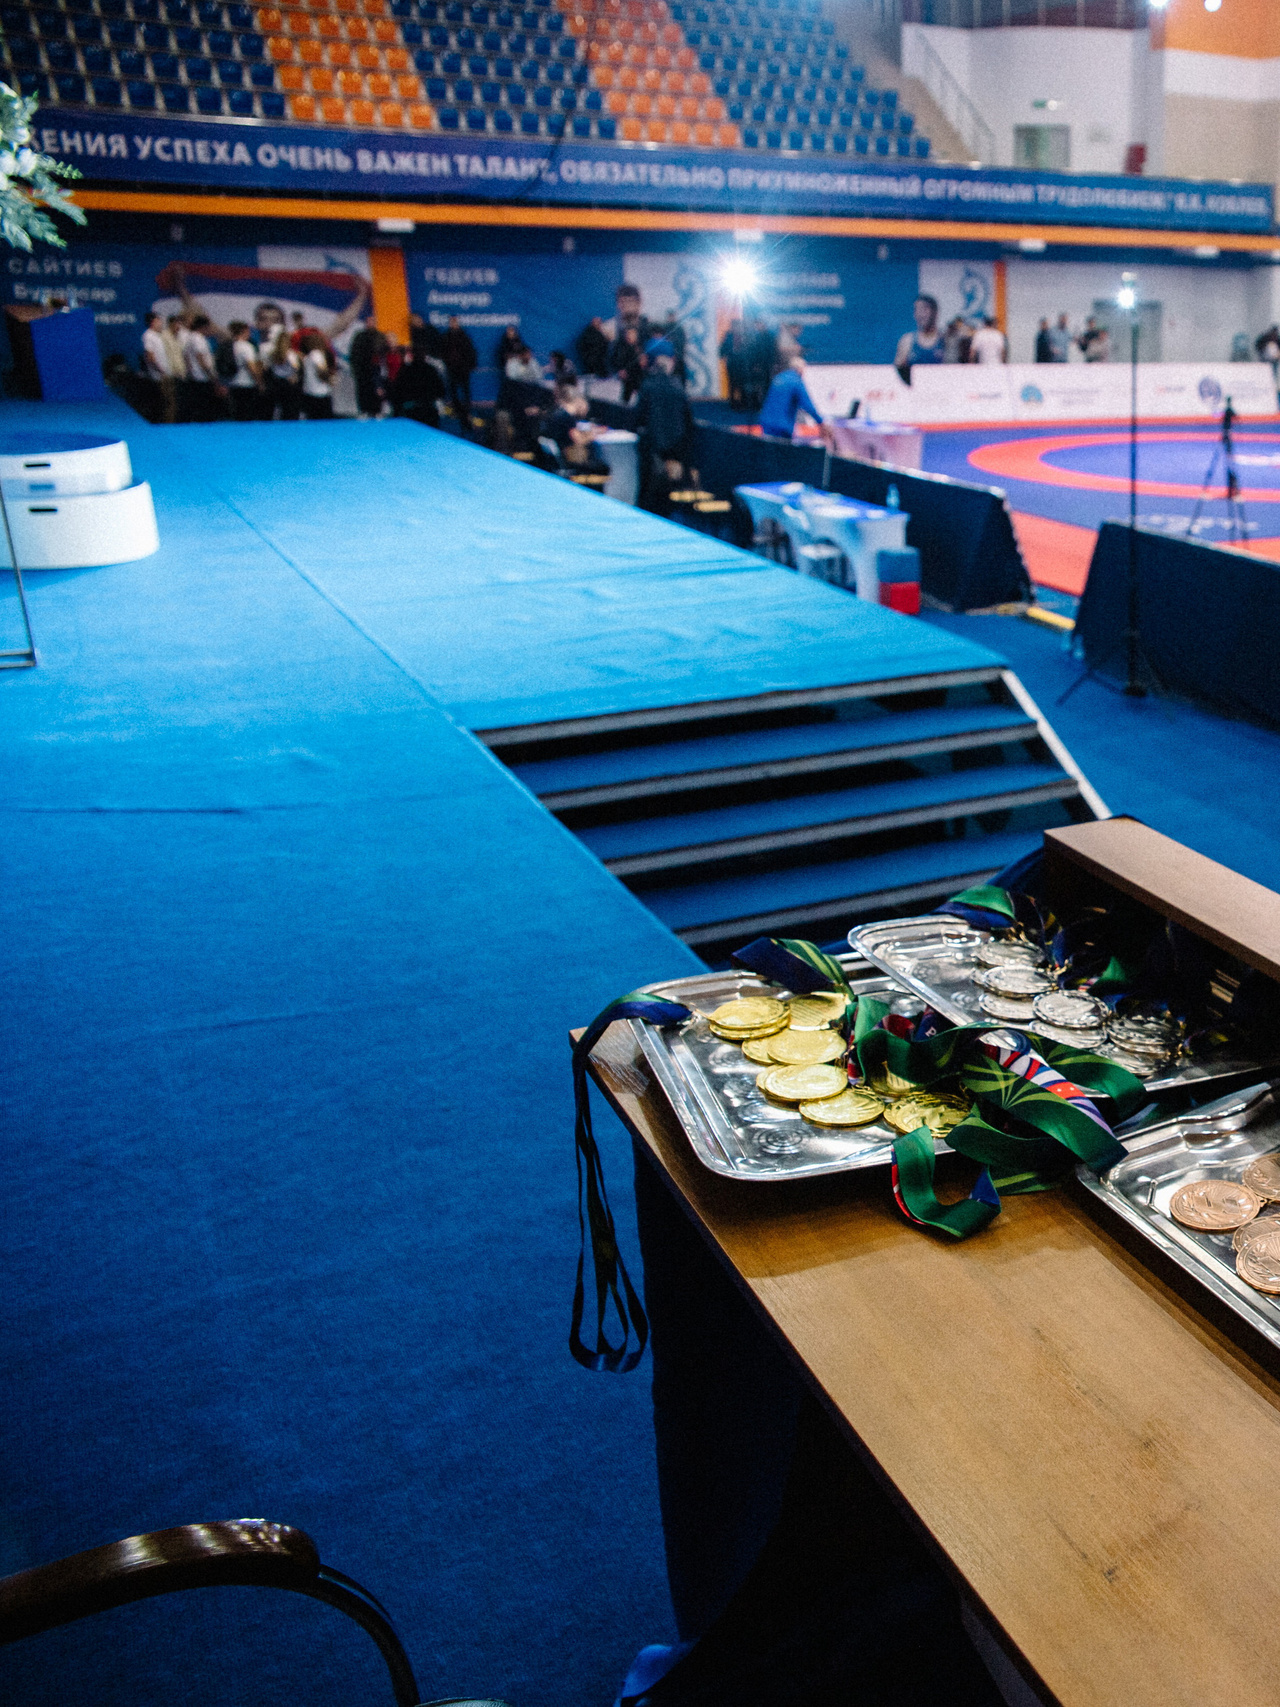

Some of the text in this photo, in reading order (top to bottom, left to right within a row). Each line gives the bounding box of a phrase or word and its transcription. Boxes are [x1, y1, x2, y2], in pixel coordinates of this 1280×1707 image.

[133, 134, 250, 167] УСПЕХА
[256, 142, 352, 173] ОЧЕНЬ
[356, 149, 450, 178] ВАЖЕН
[559, 159, 725, 189] ОБЯЗАТЕЛЬНО
[7, 256, 123, 279] САЙТИЕВ
